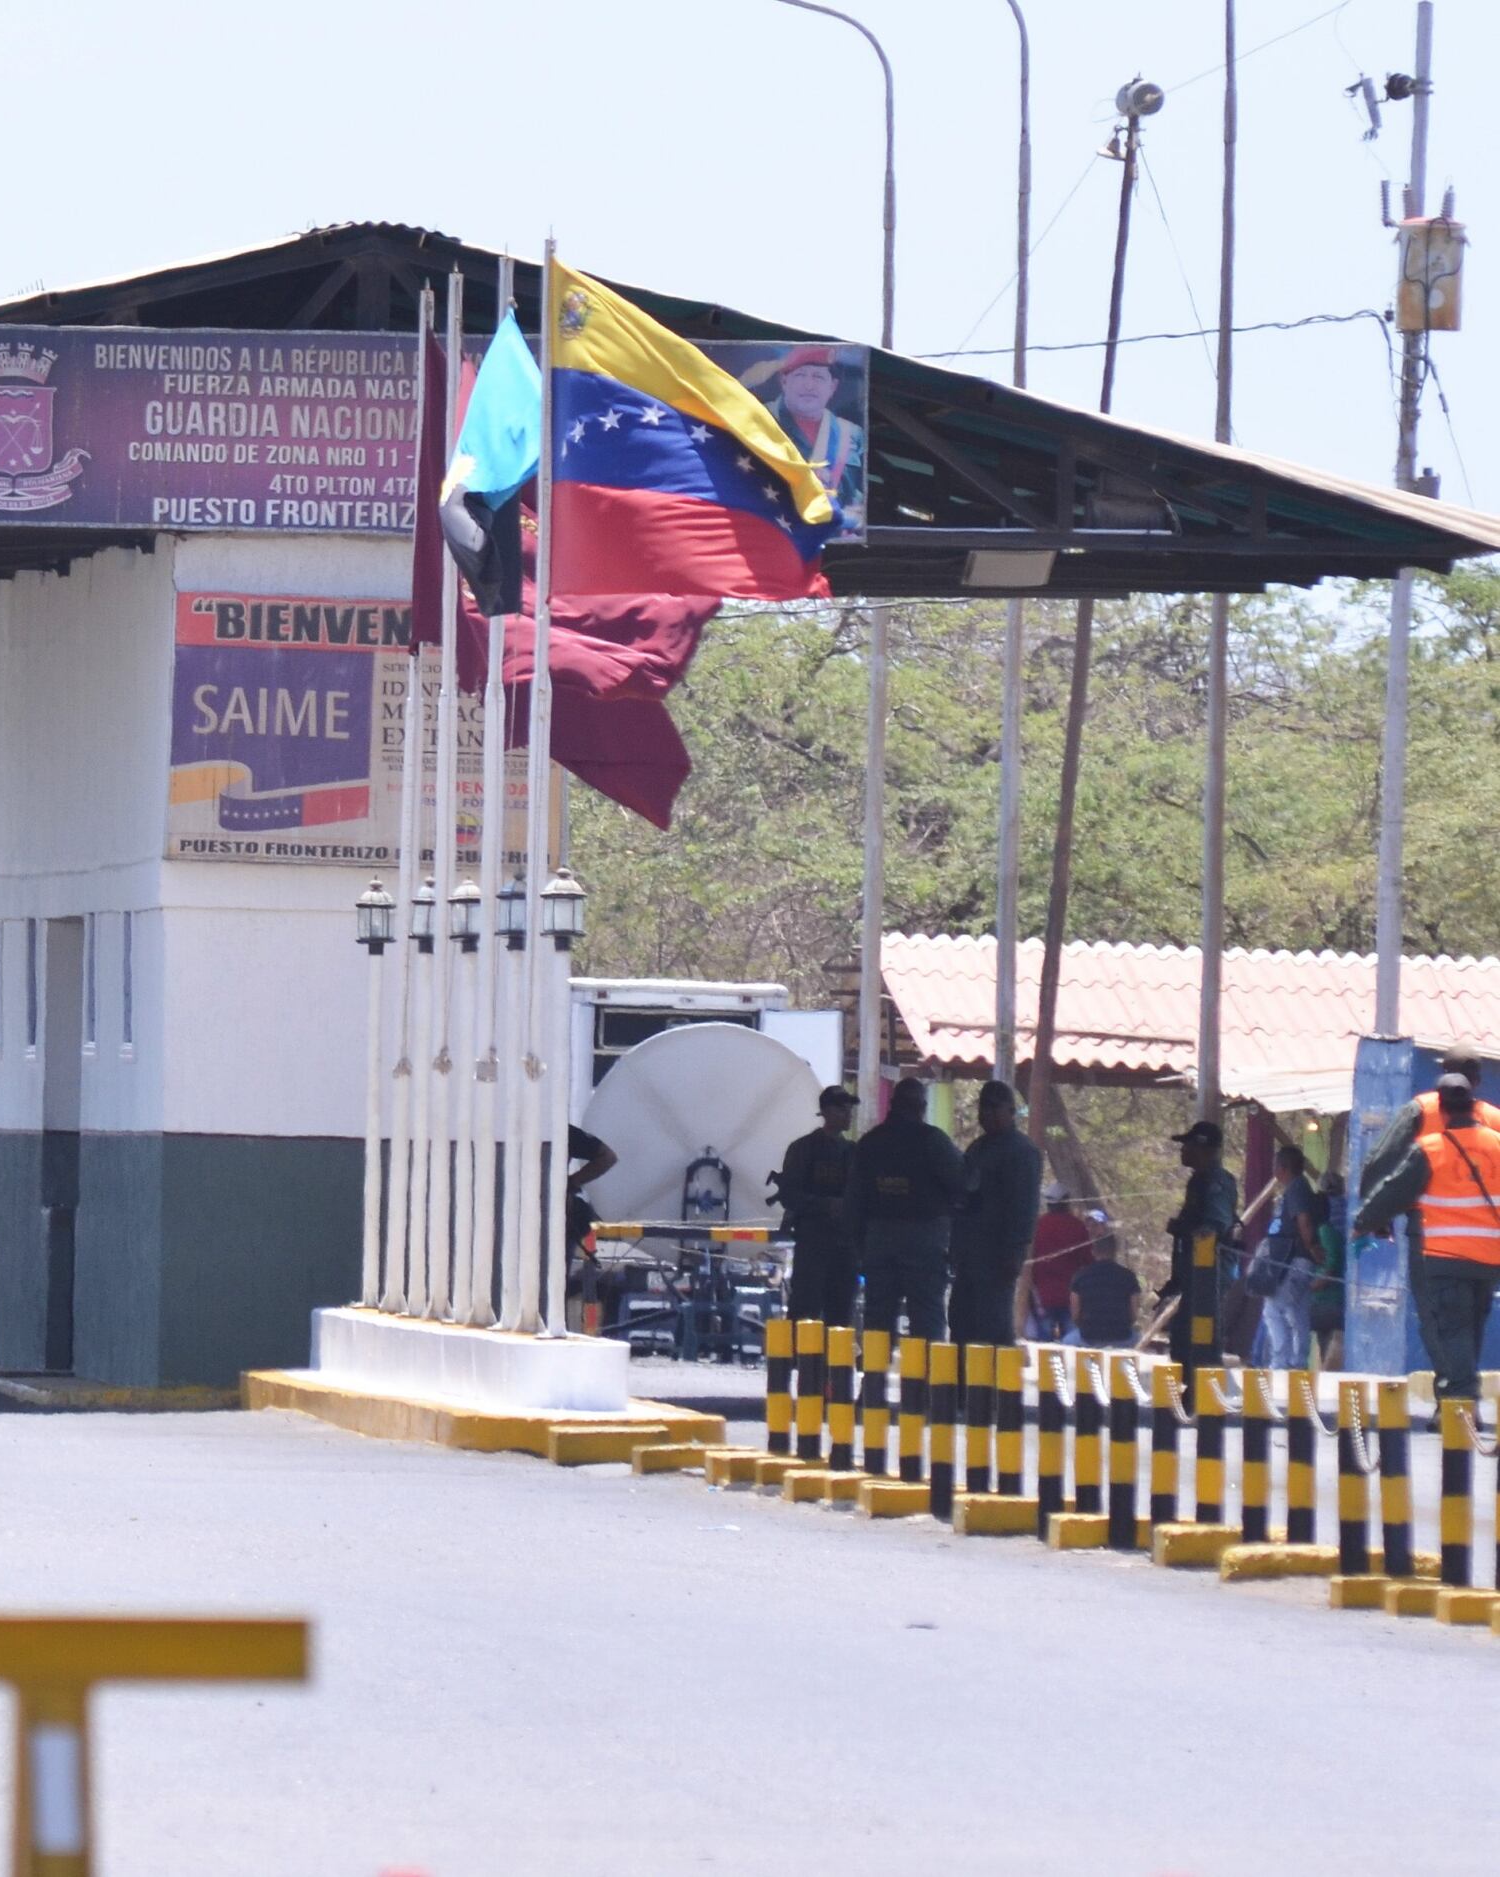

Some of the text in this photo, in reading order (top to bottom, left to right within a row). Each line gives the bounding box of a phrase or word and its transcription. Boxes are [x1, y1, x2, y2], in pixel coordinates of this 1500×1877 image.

[95, 344, 232, 371] BIENVENIDOS
[238, 347, 252, 371] A
[259, 348, 284, 373] LA
[164, 374, 419, 401] FUERZA ARMADA NACI
[146, 400, 419, 441] GUARDIA NACIONA
[129, 442, 227, 463] COMANDO
[234, 444, 259, 464] DE
[266, 445, 320, 466] ZONA
[326, 446, 366, 466] NRO
[376, 448, 398, 467] 11
[269, 474, 309, 495] 4TO
[316, 476, 375, 496] PLTON
[153, 497, 416, 528] PUESTO FRONTERIZ
[192, 598, 414, 647] “BIENVEN
[192, 684, 350, 739] SAIME
[180, 839, 259, 855] PUESTO
[265, 842, 389, 860] FRONTERIZO
